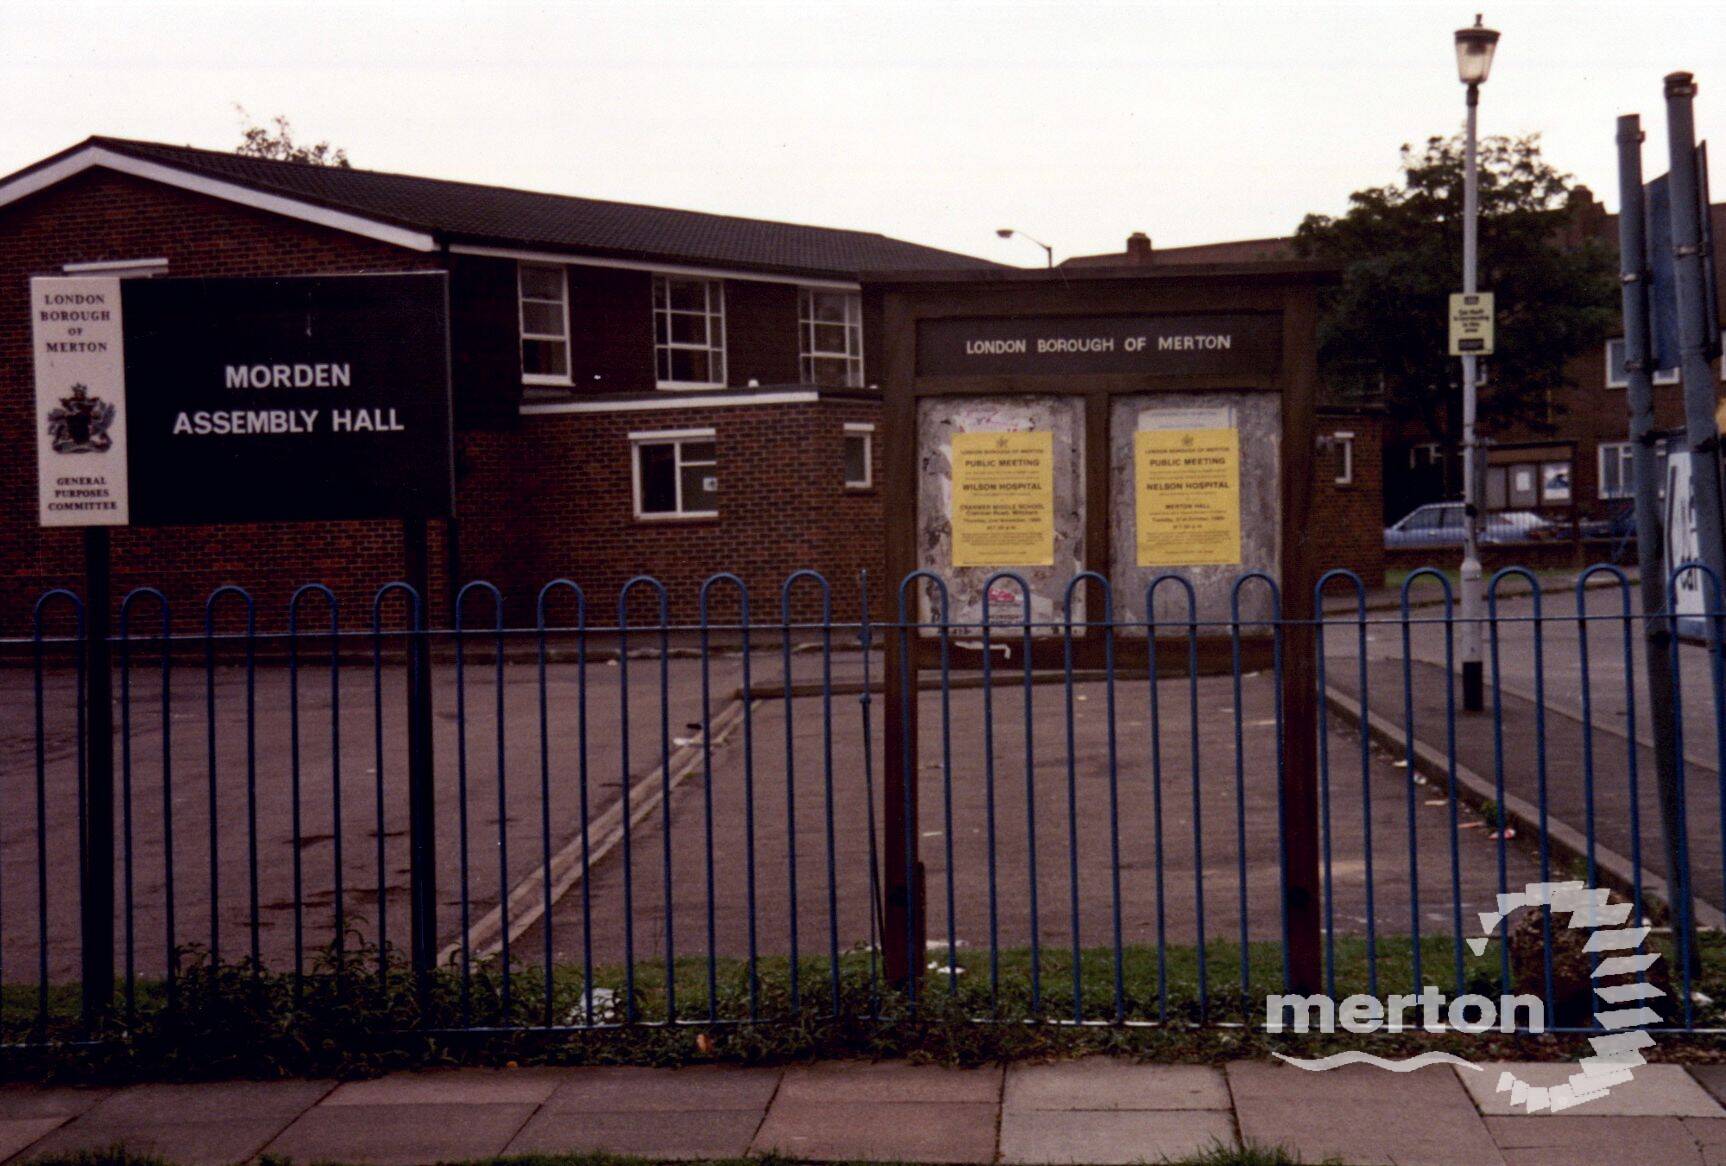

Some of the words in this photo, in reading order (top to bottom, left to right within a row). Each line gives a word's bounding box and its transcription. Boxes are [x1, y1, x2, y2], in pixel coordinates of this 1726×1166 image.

[44, 294, 104, 306] LONDON
[40, 310, 111, 322] BOROUGH
[68, 327, 83, 336] OF
[46, 342, 108, 353] MERTON
[966, 340, 1026, 354] LONDON
[1038, 338, 1114, 353] BOROUGH
[1125, 337, 1146, 351] OF
[1158, 335, 1231, 350] MERTON
[226, 364, 350, 388] MORDEN
[173, 409, 318, 434] ASSEMBLY
[332, 408, 404, 432] HALL
[1150, 458, 1181, 466] PUBLIC
[1184, 457, 1225, 466] MEETING
[56, 476, 106, 486] GENERAL
[54, 489, 110, 498] PURPOSES
[48, 502, 118, 511] COMMITTEE
